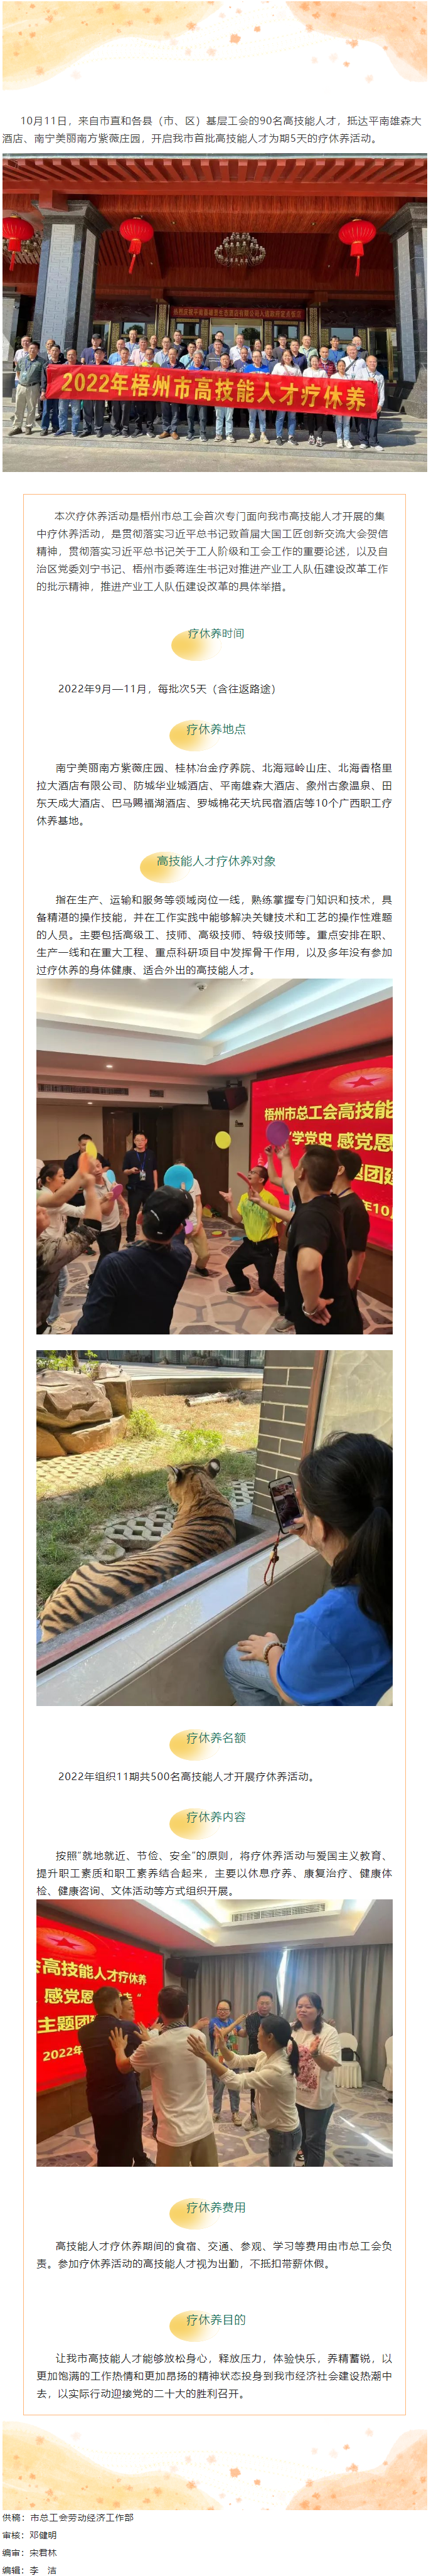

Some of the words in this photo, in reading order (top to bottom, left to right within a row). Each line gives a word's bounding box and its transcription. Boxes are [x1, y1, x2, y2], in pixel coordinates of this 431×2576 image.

[21, 115, 422, 127] 10月11日，来自市直和各县（市、区）基层工会的90名高技能人才，抵达平南雄森大
[2, 132, 376, 144] 酒店、南宁美丽南方紫薇庄园，开启我市首批高技能人才为期5天的疗休养活动。
[61, 372, 366, 411] 2022年梧州市高技能人才疗休养
[54, 510, 385, 522] 本次疗休养活动是梧州市总工会首次专门面向我市高技能人才开展的集
[36, 528, 388, 539] 中疗休养活动，是贯彻落实习近平总书记致首届大国工匠创新交流大会贺信
[36, 545, 388, 557] 精神，贯彻落实习近平总书记关于工人阶级和工会工作的重要论述，以及自
[36, 563, 388, 574] 治区党委刘宁书记、梧州市委蒋连生书记对推进产业工人队伍建设改革工作
[36, 581, 287, 592] 的批示精神，推进产业工人队伍建设改革的具体举措。
[188, 628, 245, 639] 疗休养时间
[186, 723, 246, 736] 疗休养地点
[55, 762, 393, 773] 南宁美丽南方紫薇庄园、桂林冶金疗养院、北海冠岭山庄、北海香格里
[36, 780, 392, 791] 拉大酒店有限公司、防城华业城酒店、平南雄森大酒店、象州古象温泉、田
[36, 797, 393, 808] 东天成大酒店、巴马赐福湖酒店、罗城棉花天坑民宿酒店等10个广西职工疗
[36, 815, 83, 826] 休养基地。
[156, 855, 276, 867] 高技能人才疗休养对象
[55, 894, 393, 905] 指在生产、运输和服务等领域岗位一线，熟练掌握专门知识和技术，具
[36, 911, 393, 923] 备精湛的操作技能，并在工作实践中能够解决关键技术和工艺的操作性难题
[36, 930, 386, 940] 的人员。主要包括高级工、技师、高级技师、特级技师等。重点安排在职、
[36, 947, 392, 958] 生产一线和在重大工程、重点科研项目中发挥骨干作用，以及多年没有参加
[36, 965, 255, 975] 过疗休养的身体健康、适合外出的高技能人才。
[265, 1100, 393, 1120] 梧州市总工会高技能
[337, 1132, 393, 1152] 感党恩
[186, 1732, 246, 1744] 疗休养名额
[58, 1771, 313, 1782] 2022年组织11期共500名高技能人才开展疗休养活动。
[186, 1811, 246, 1823] 疗休养内容
[36, 1867, 393, 1879] 提升职工素质和职工素养结合起来，主要以休息疗养、康复治疗、健康体
[36, 1885, 233, 1896] 检、健康咨询、文体活动等方式组织开展。
[186, 2201, 246, 2214] 疗休养费用
[55, 2240, 392, 2251] 高技能人才疗休养期间的食宿、交通、参观、学习等费用由市总工会负
[36, 2258, 329, 2270] 责。参加疗休养活动的高技能人才视为出勤，不抵扣带薪休假。
[186, 2314, 246, 2326] 疗休养目的
[55, 2353, 392, 2364] 让我市高技能人才能够放松身心，释放压力，体验快乐，养精蓄锐，以
[36, 2370, 392, 2381] 更加饱满的工作热情和更加昂扬的精神状态投身到我市经济社会建设热潮中
[36, 2388, 243, 2399] 去，以实际行动迎接党的二十大的胜利召开。
[2, 2513, 134, 2522] 供稿：市总工会劳动经济工作部
[2, 2531, 57, 2540] 审核：邓健明
[2, 2548, 57, 2557] 编审：宋君林
